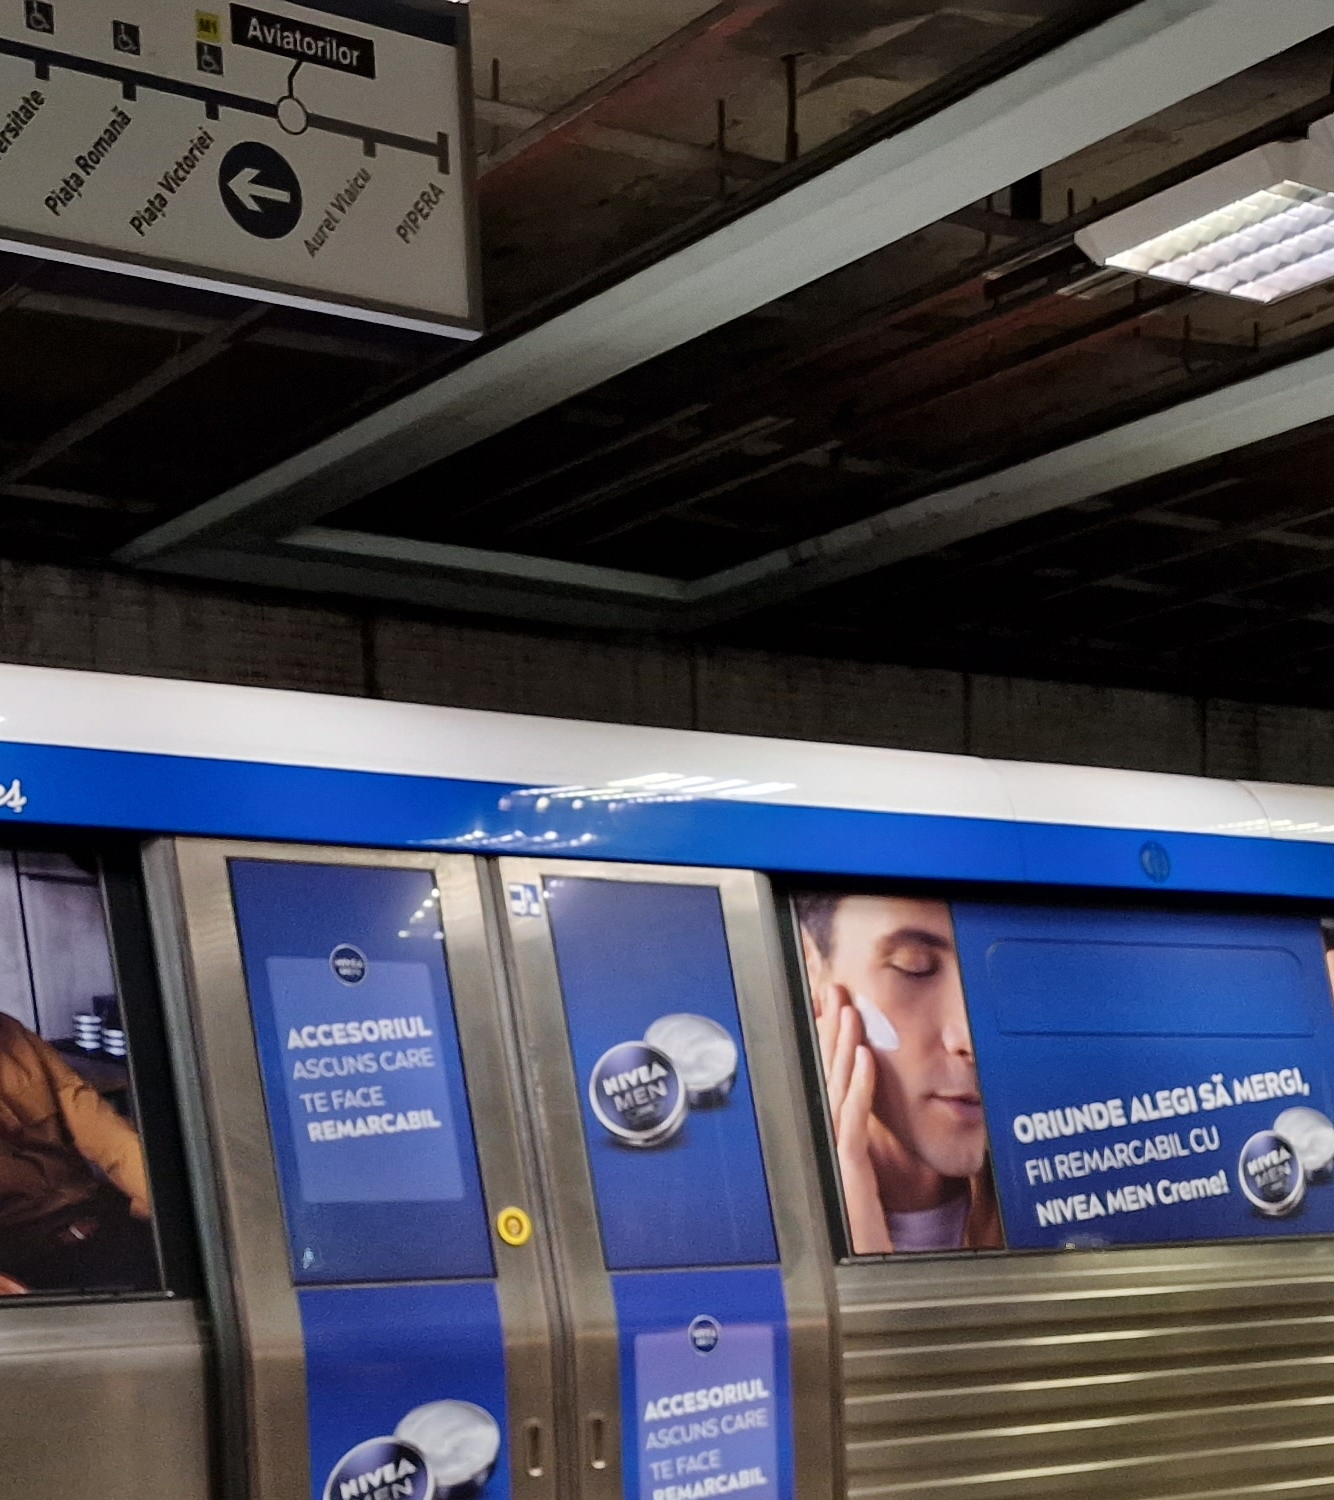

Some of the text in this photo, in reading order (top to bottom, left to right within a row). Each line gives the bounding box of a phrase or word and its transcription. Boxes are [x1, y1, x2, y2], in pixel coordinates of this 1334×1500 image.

[248, 17, 361, 67] Aviatorilor
[44, 105, 132, 217] Piața Romană
[129, 126, 215, 237] Piața Victoriei
[303, 167, 372, 258] Aurel Vlaicu
[395, 182, 446, 244] PIPERA
[287, 1015, 433, 1049] ACCESORIUL
[293, 1047, 436, 1080] ASCUNS CARE
[602, 1061, 668, 1096] NIVEA
[299, 1085, 387, 1113] TE FACE
[613, 1080, 668, 1112] MEN
[1013, 1067, 1310, 1144] ORIUNDE ALEGI SĂ MERGI,
[307, 1108, 443, 1143] REMARCABIL
[1025, 1125, 1221, 1186] FII REMARCABIL CU
[1035, 1169, 1230, 1228] NIVEA MEN Creme!
[644, 1377, 770, 1422] ACCESORIUL
[645, 1407, 770, 1450] ASCUNS CARE
[339, 1458, 418, 1500] NIVEA
[650, 1448, 722, 1482] TE FACE
